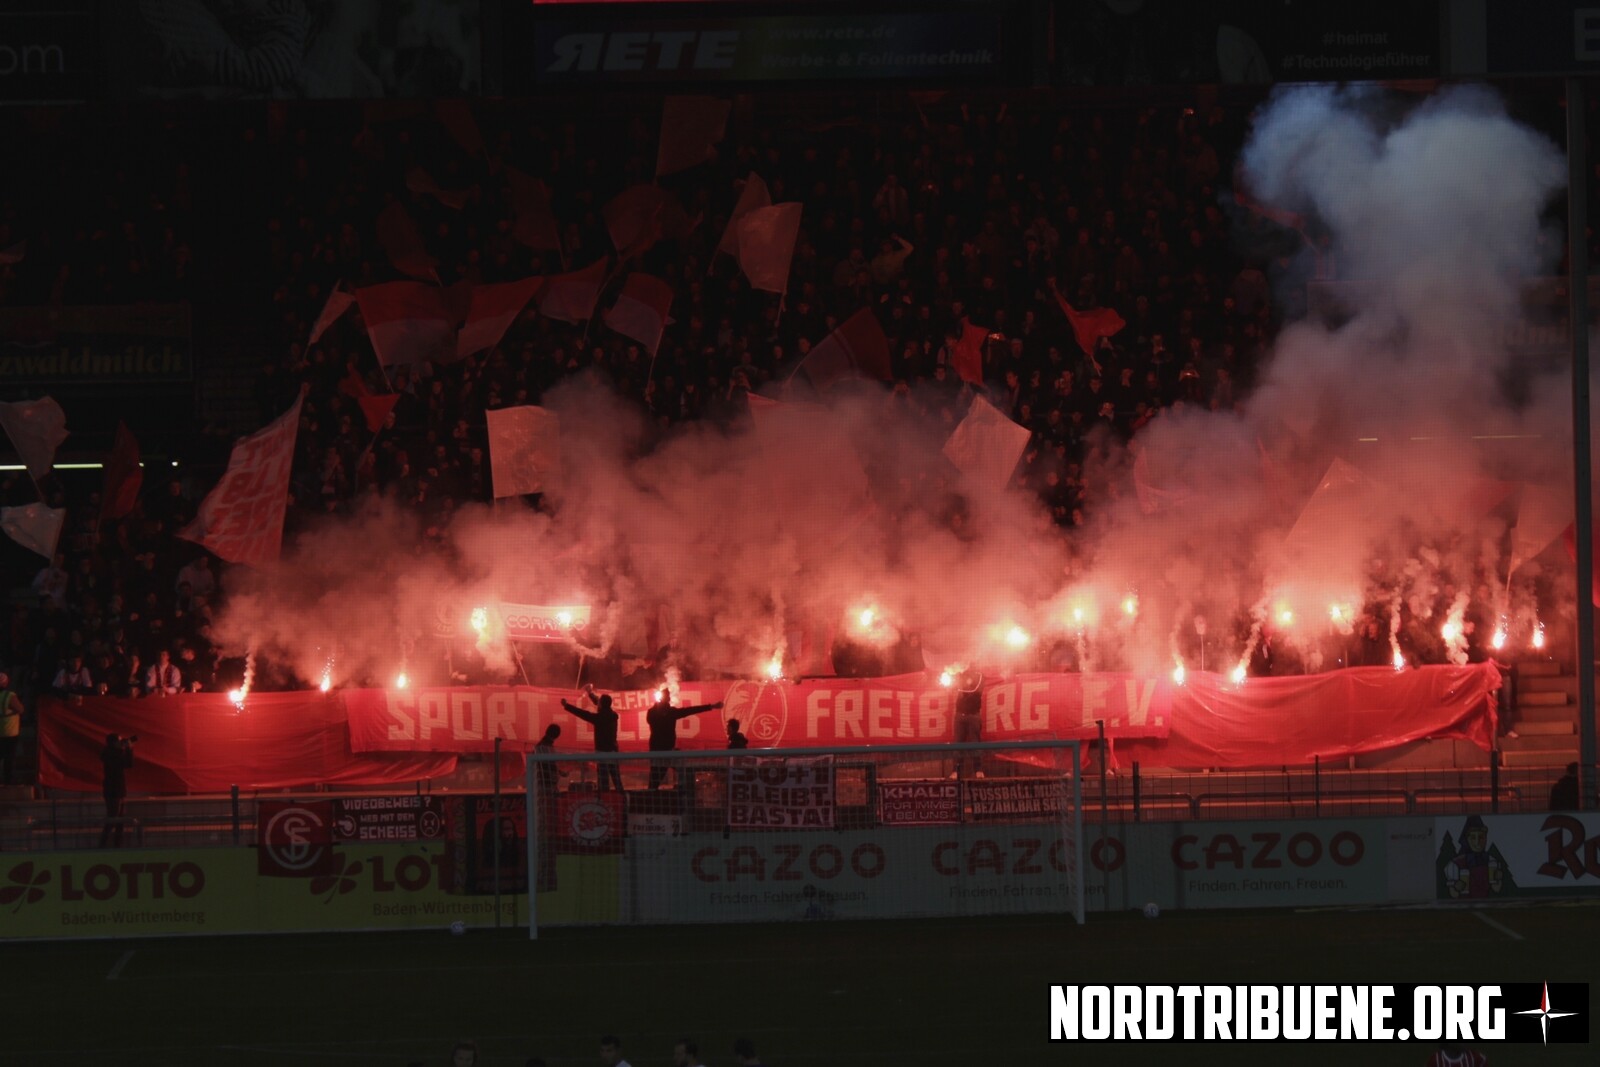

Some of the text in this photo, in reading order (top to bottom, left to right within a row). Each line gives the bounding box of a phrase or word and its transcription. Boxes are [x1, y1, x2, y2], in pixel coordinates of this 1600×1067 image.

[768, 25, 896, 40] www.rete.de
[1322, 31, 1389, 45] #heimat
[760, 49, 993, 67] Werbe- & Folientechnik
[1281, 52, 1430, 71] #Technologieführer
[807, 682, 1049, 738] FREIBRG
[1083, 679, 1163, 727] E.V.
[732, 784, 831, 806] BLEIBT.
[884, 786, 958, 799] KHALID
[971, 783, 1032, 801] FUSSBALL
[343, 796, 432, 810] VIDEOBEWEIS ?
[380, 813, 395, 822] MIT
[397, 813, 415, 821] DEM
[731, 806, 831, 826] BASTA!
[895, 811, 948, 820] BEI UNS
[360, 825, 416, 839] SCHEISS
[1171, 831, 1364, 870] CAZOO
[691, 843, 886, 882] CAZOO
[61, 861, 205, 901] LOTTO
[1189, 876, 1348, 892] Finden. Fahren. Freuen.
[710, 892, 761, 905] Finden.
[950, 885, 1000, 898] Finden.
[61, 909, 205, 925] Baden-Württemberg
